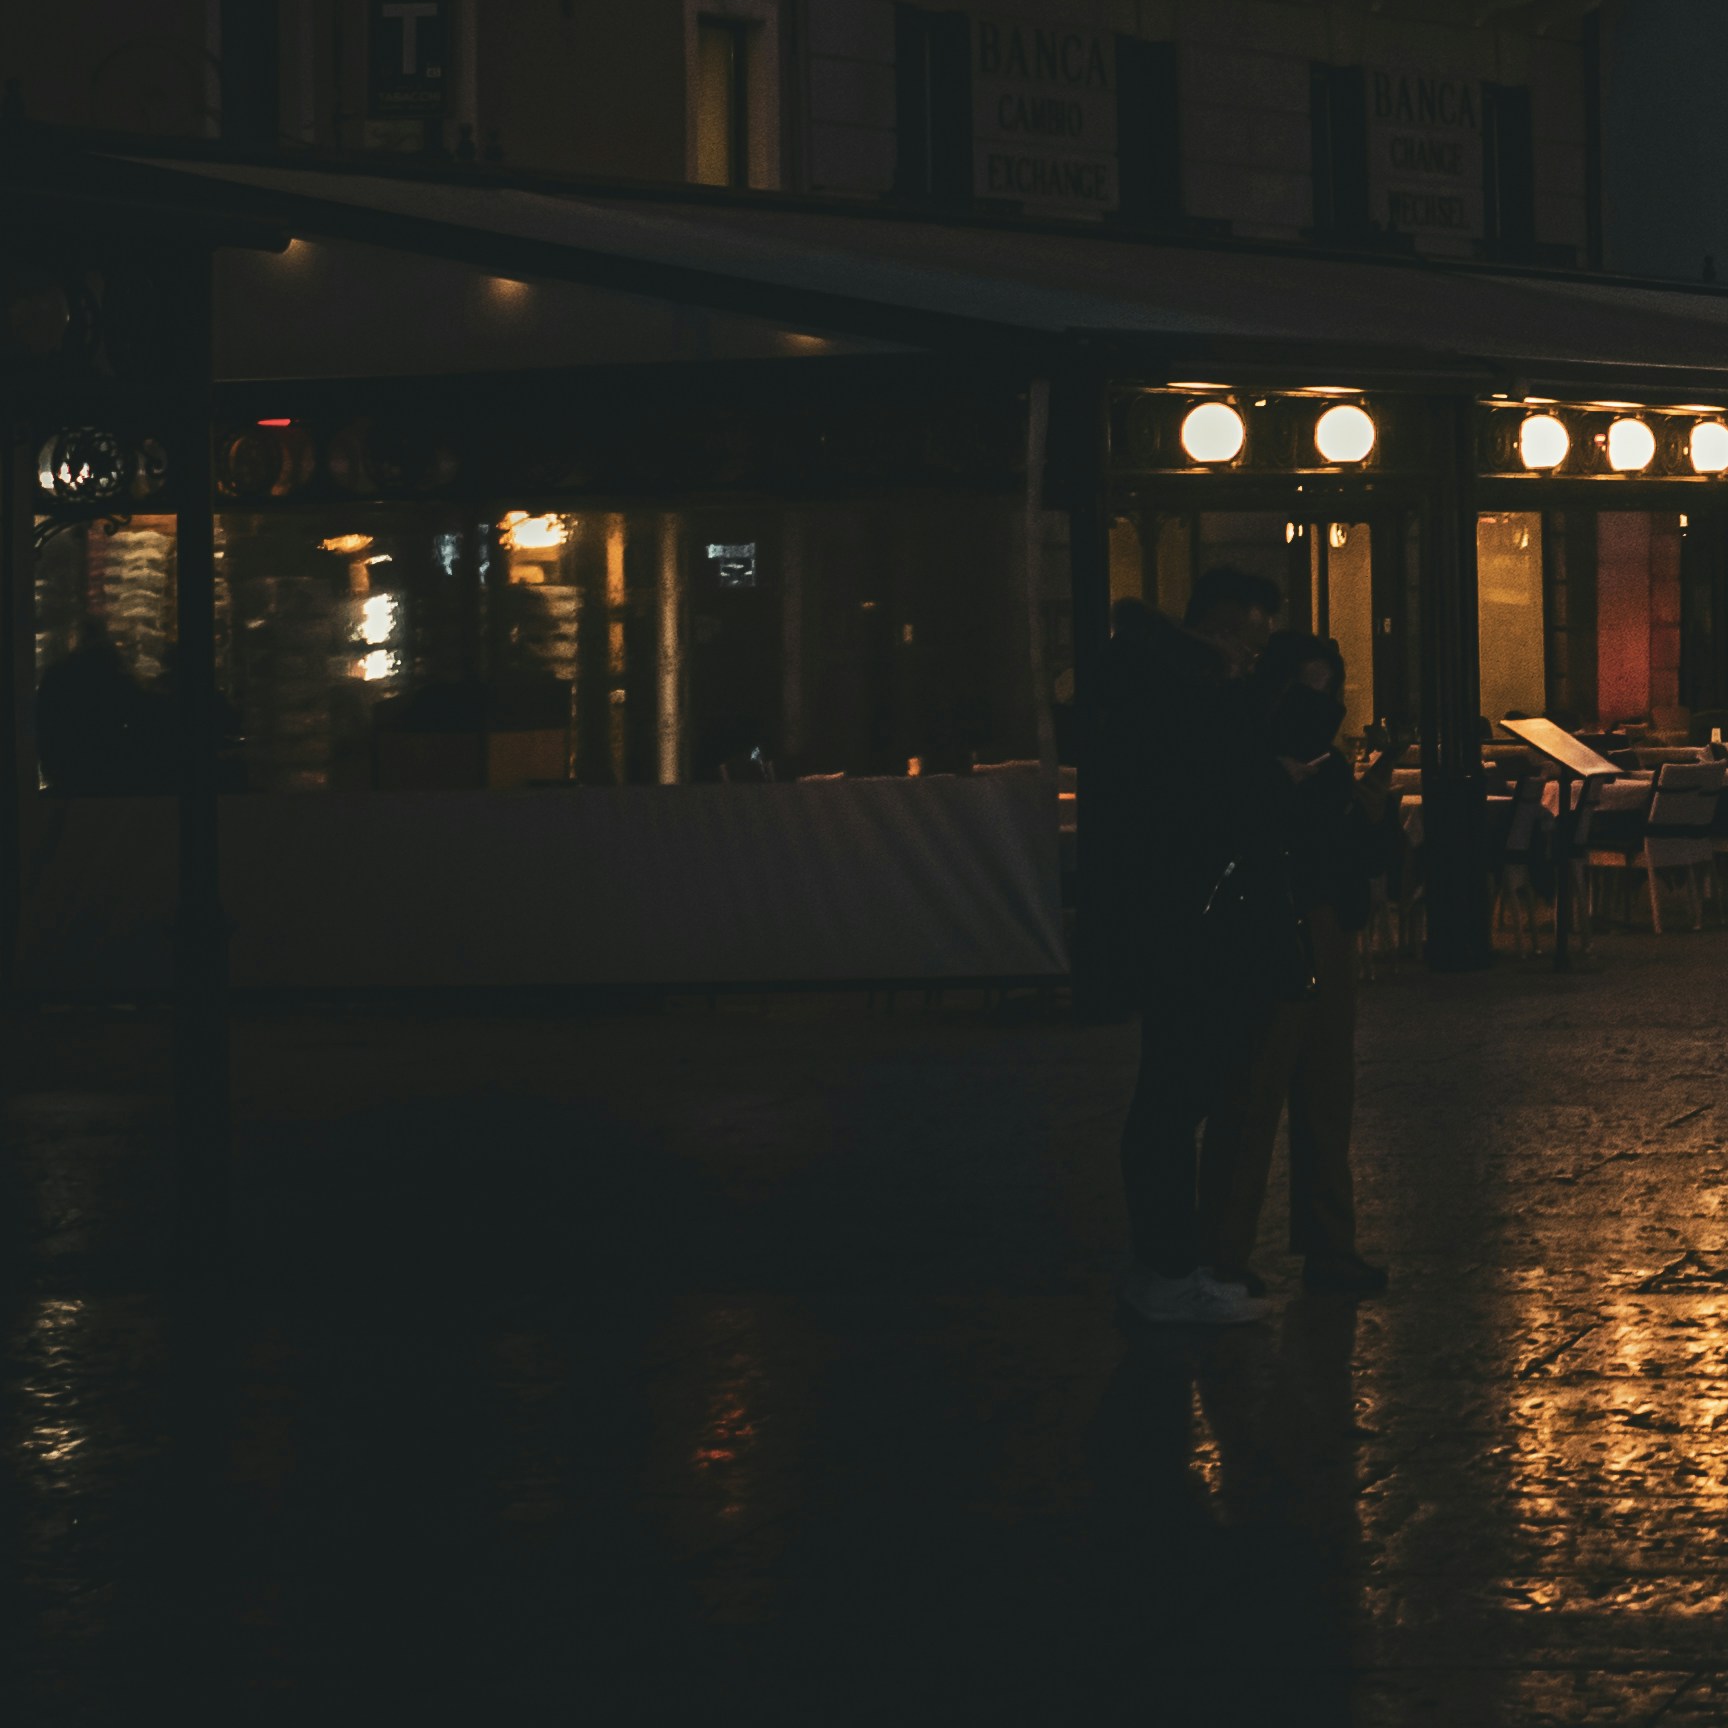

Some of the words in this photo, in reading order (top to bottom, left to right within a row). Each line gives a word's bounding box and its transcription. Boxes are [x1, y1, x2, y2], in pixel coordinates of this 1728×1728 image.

[382, 3, 438, 74] T
[978, 21, 1107, 87] BANCA
[379, 90, 442, 103] TABACCHI
[997, 94, 1084, 138] CAMBIO
[1374, 71, 1477, 129] BANCA
[988, 153, 1109, 202] EXCHANGE
[1391, 137, 1464, 176] CHANGE
